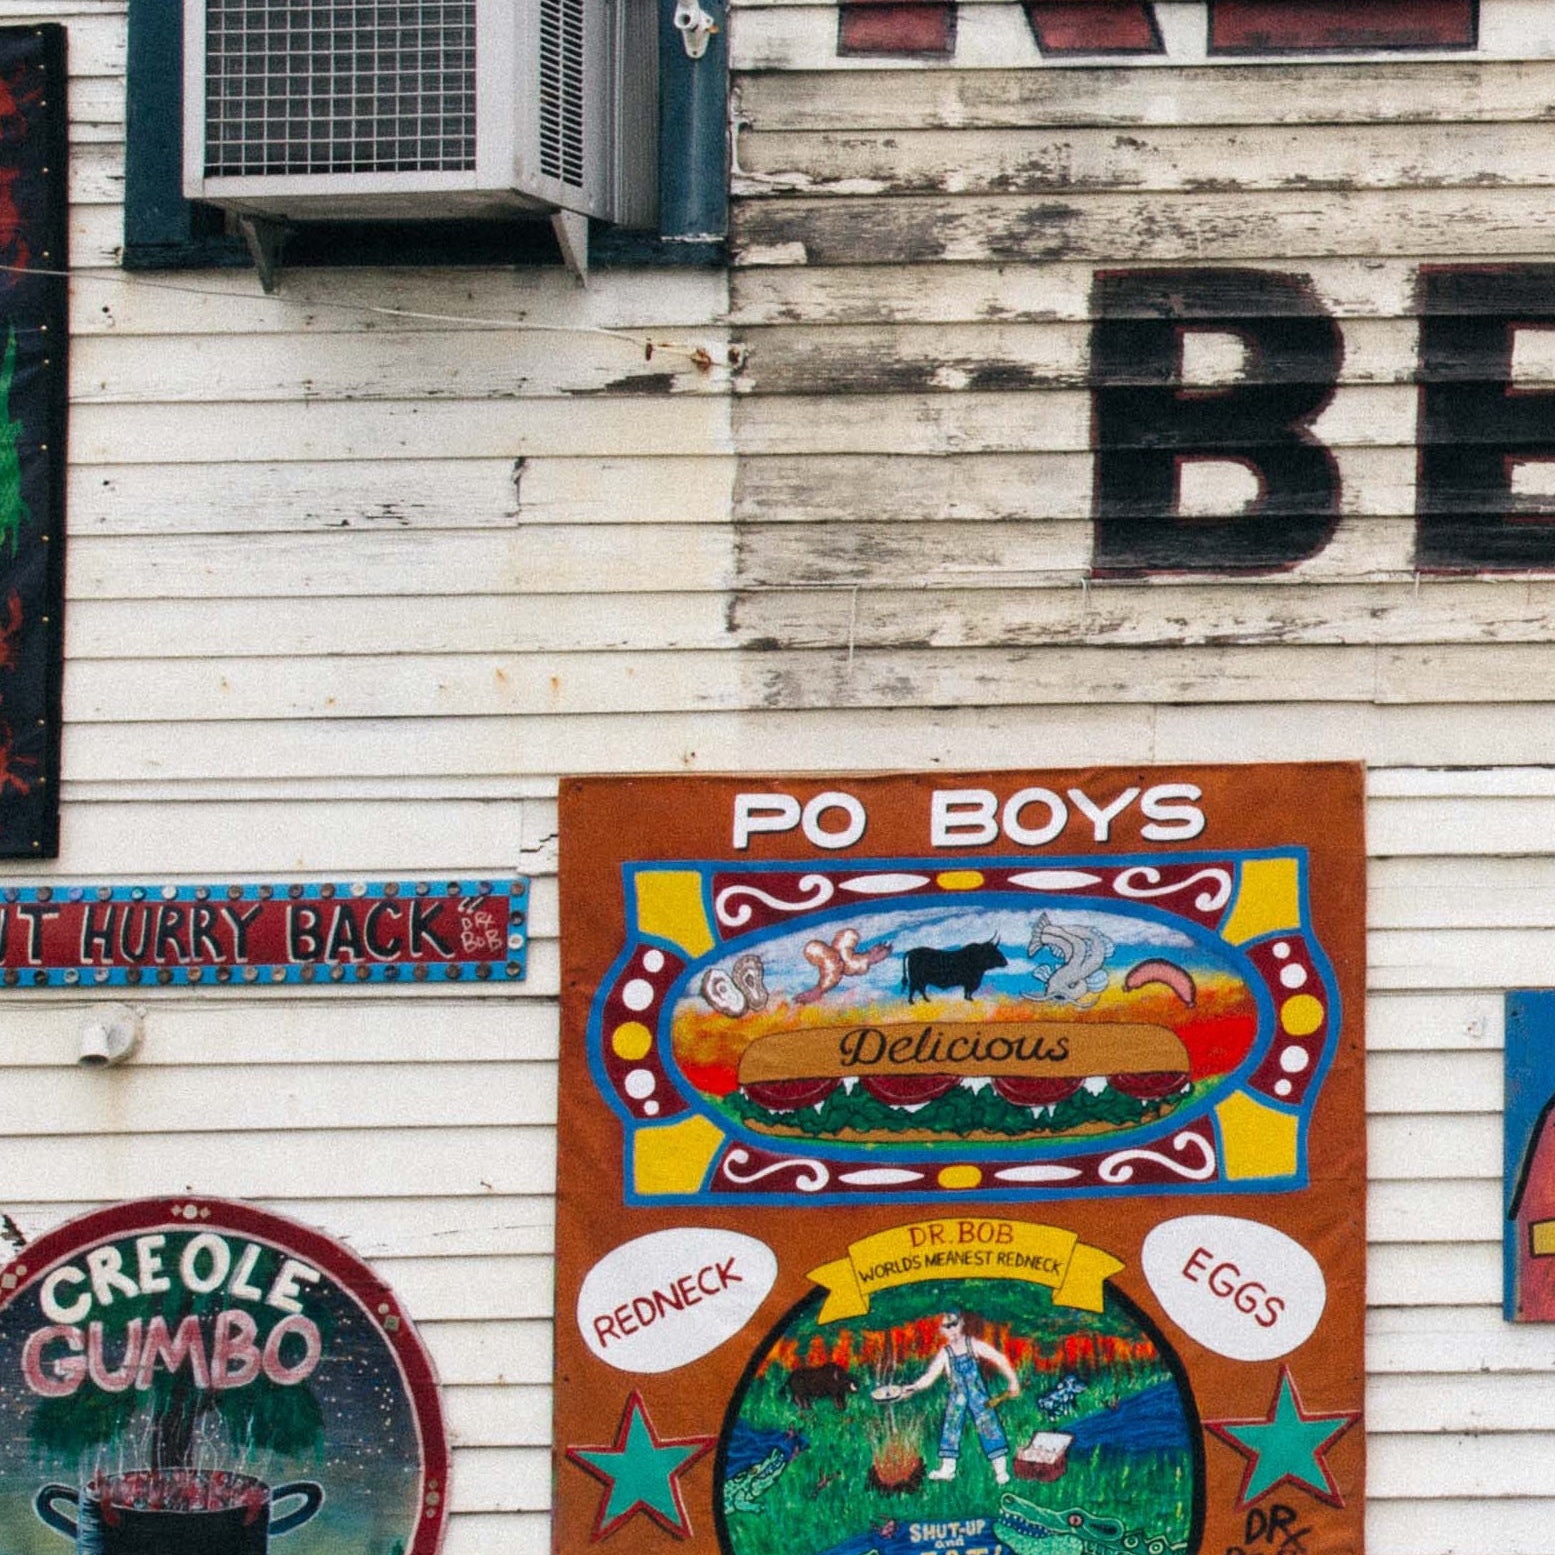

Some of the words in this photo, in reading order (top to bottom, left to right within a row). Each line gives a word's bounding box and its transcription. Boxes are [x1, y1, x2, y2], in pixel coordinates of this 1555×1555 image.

[733, 790, 867, 848] PO
[931, 783, 1206, 847] BOYS
[0, 905, 60, 965] T
[80, 904, 263, 964] HURRY
[839, 1026, 1069, 1066] Delicious
[924, 1250, 993, 1268] MEANEST
[997, 1249, 1064, 1277] REDNECK
[958, 1220, 1014, 1245] BOB
[39, 1231, 321, 1326] CREOLE
[593, 1256, 743, 1348] REDNECK
[1182, 1246, 1286, 1328] EGGS
[20, 1307, 323, 1398] GUMBO
